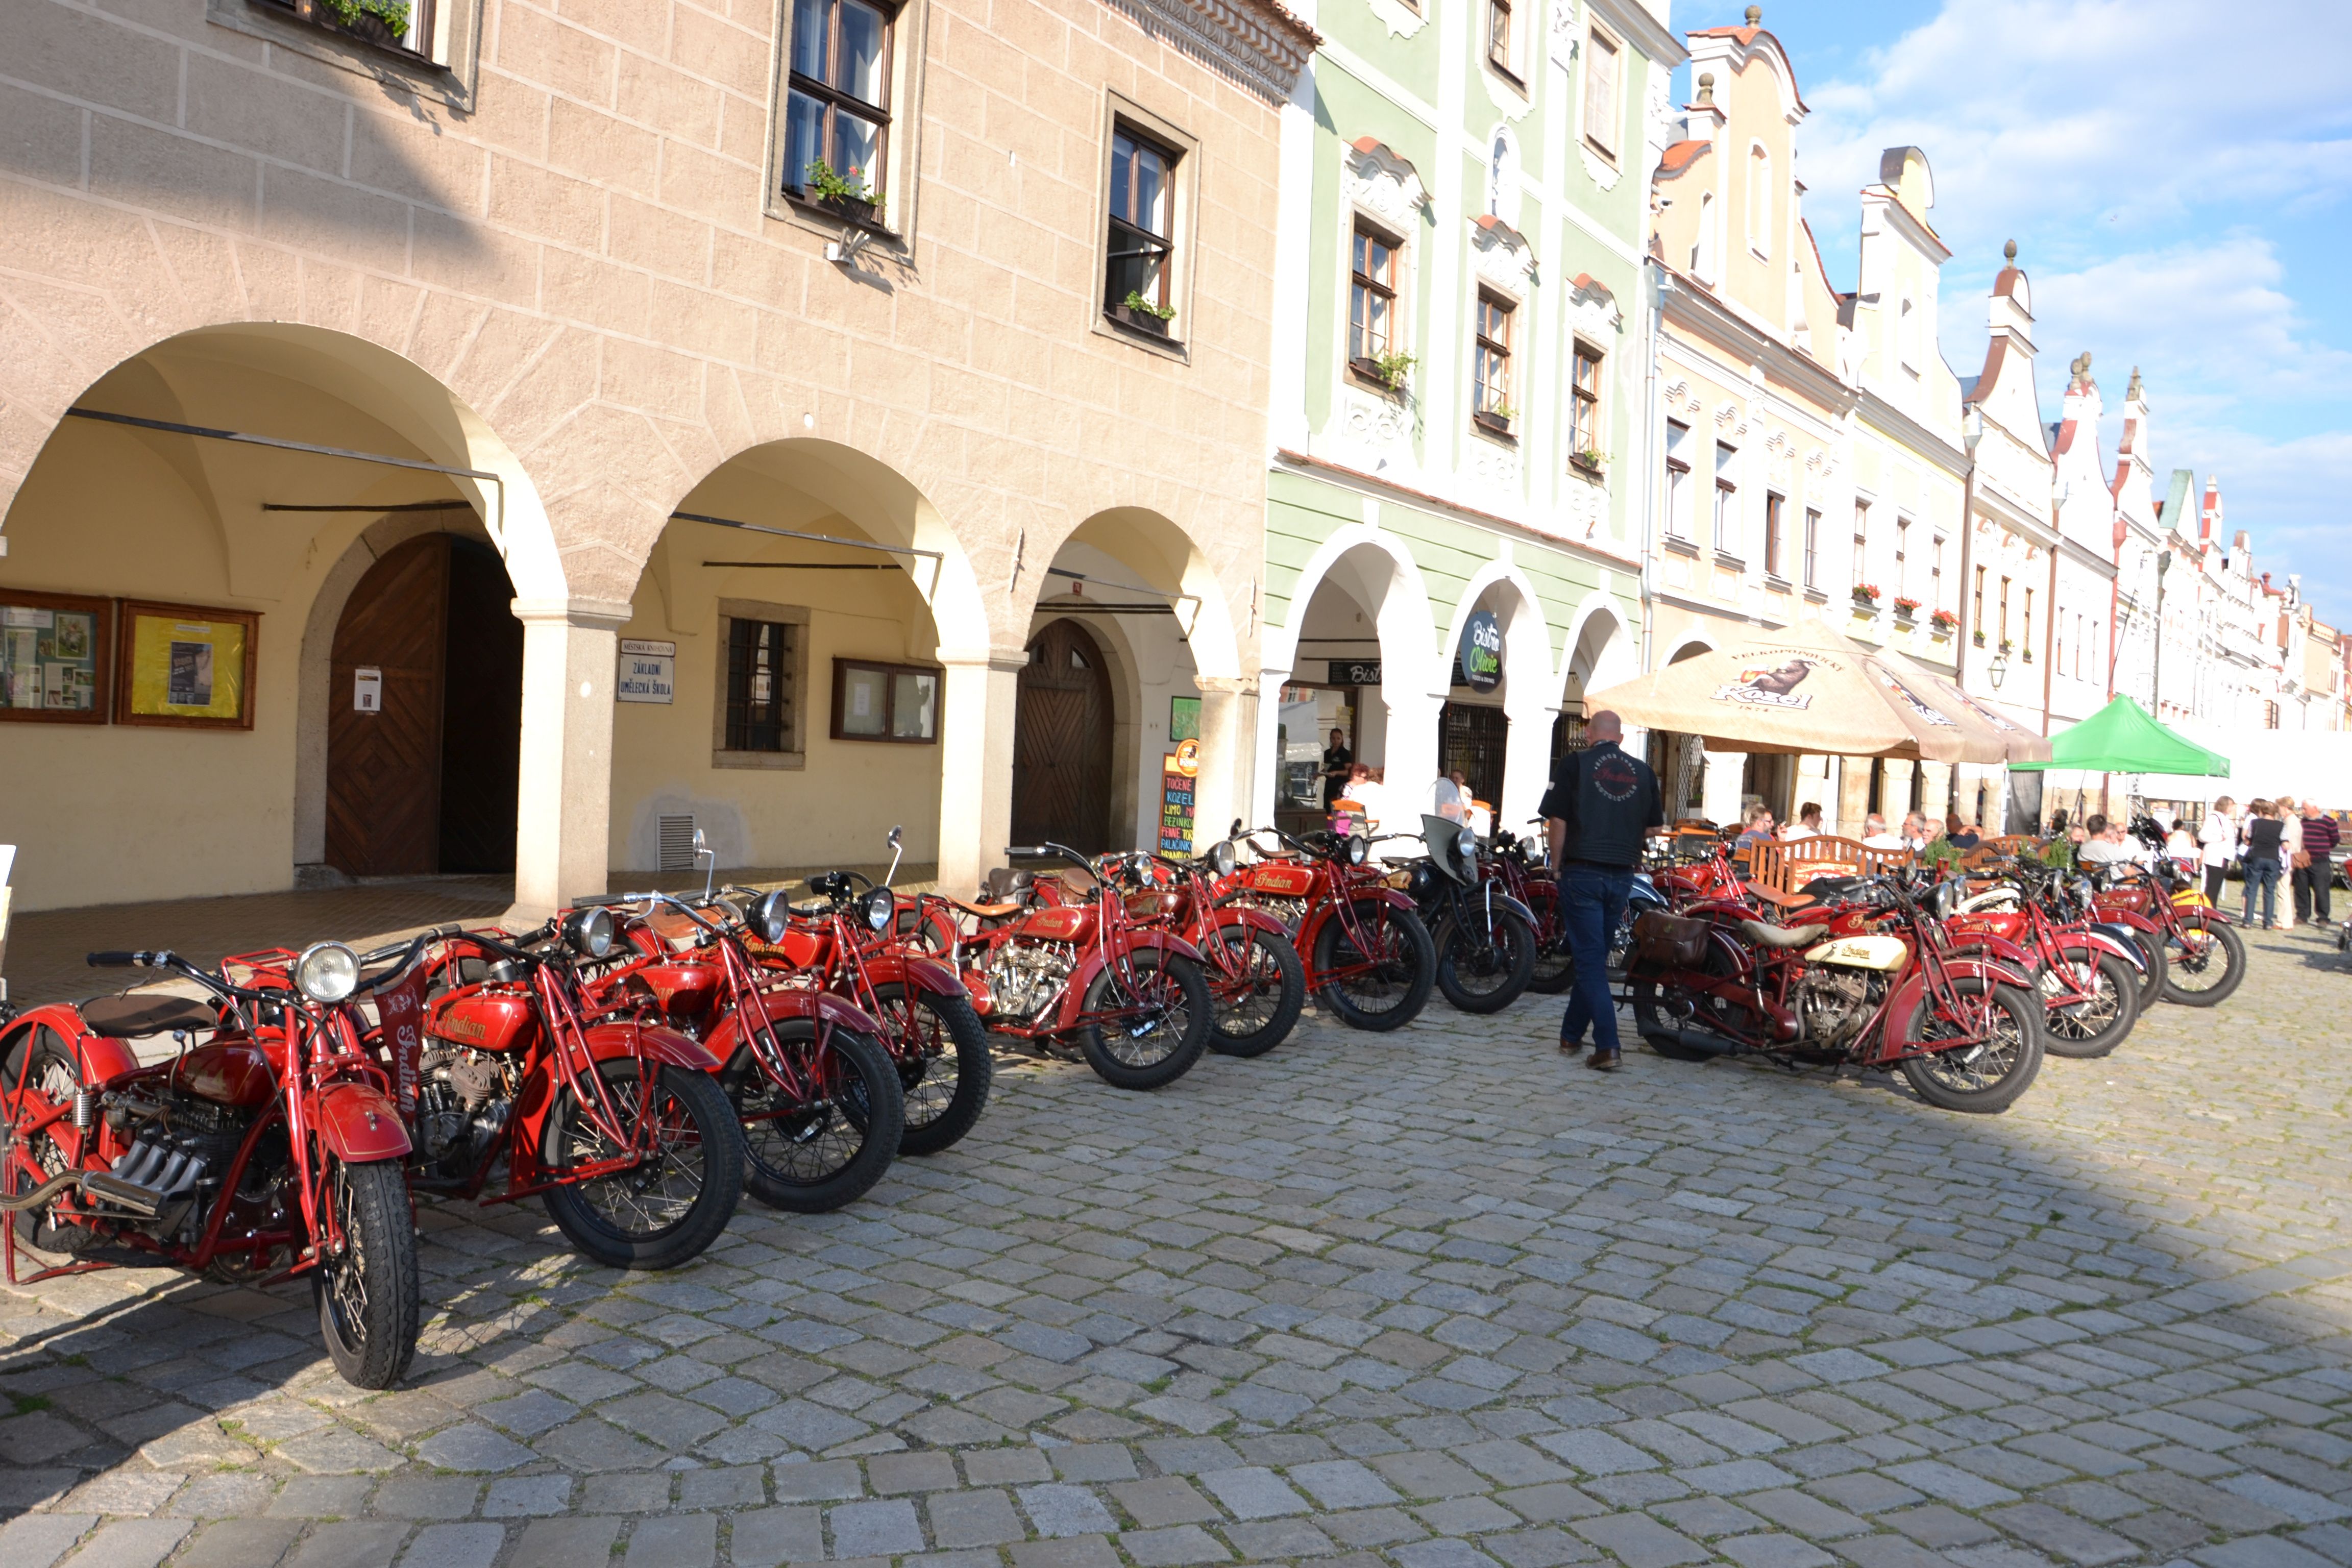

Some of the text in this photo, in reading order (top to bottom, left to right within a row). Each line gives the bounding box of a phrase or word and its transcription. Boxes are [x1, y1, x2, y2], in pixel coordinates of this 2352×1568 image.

[1473, 620, 1500, 652] Bistro
[624, 642, 673, 653] MĚSTSKÁ KNIHOVNA
[633, 659, 662, 676] ZÁKLADNÍ
[1469, 646, 1498, 674] Olivie
[1731, 649, 1846, 672] VELKOPOPOVICKÝ
[620, 677, 671, 695] UMĚLECKÁ ŠKOLA
[1709, 683, 1813, 710] Kozel
[1166, 776, 1192, 791] TOČENÉ
[1166, 791, 1194, 805] KOZEL
[1164, 804, 1181, 816] LIMO
[1164, 815, 1194, 828] BEZINKO
[1161, 826, 1181, 839] PENNE
[1256, 871, 1292, 889] Indian
[1036, 914, 1064, 928] Indian
[1841, 943, 1870, 957] Indian
[439, 1005, 486, 1040] Indian
[397, 1024, 418, 1113] Indian
